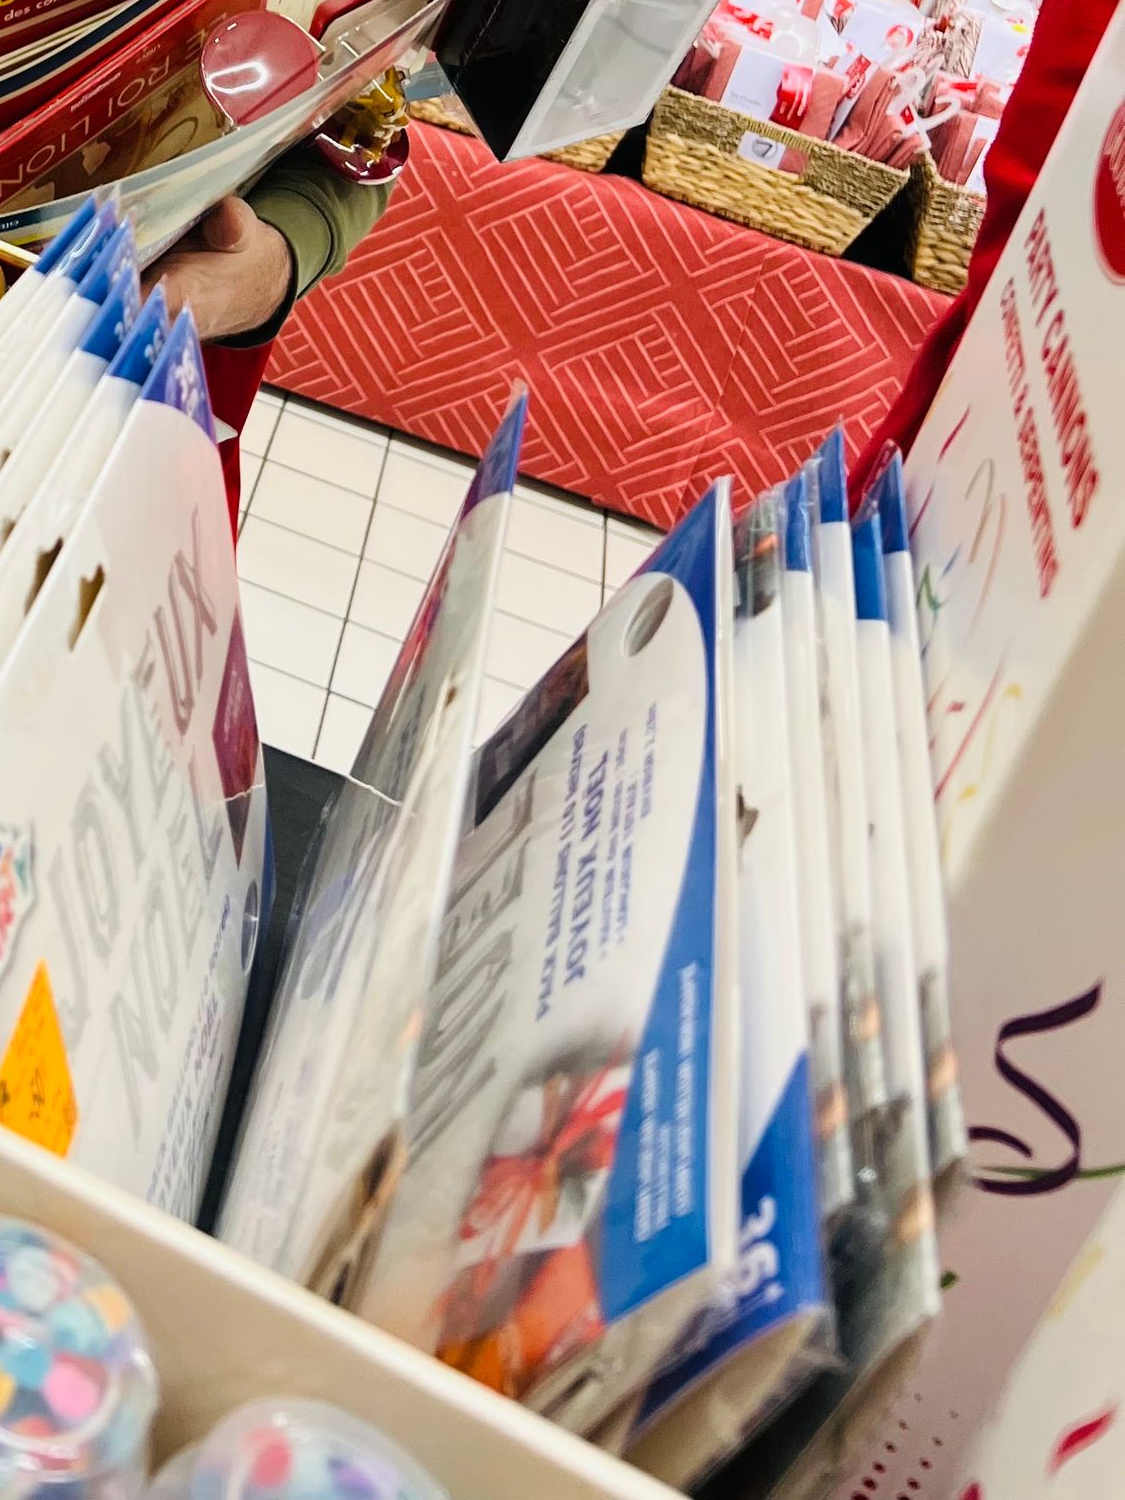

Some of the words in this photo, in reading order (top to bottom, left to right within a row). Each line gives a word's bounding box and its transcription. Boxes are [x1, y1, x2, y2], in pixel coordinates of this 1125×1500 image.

[4, 6, 31, 24] des
[106, 59, 171, 106] ROI
[580, 748, 610, 843] NOËL
[563, 839, 601, 987] JOYEUX
